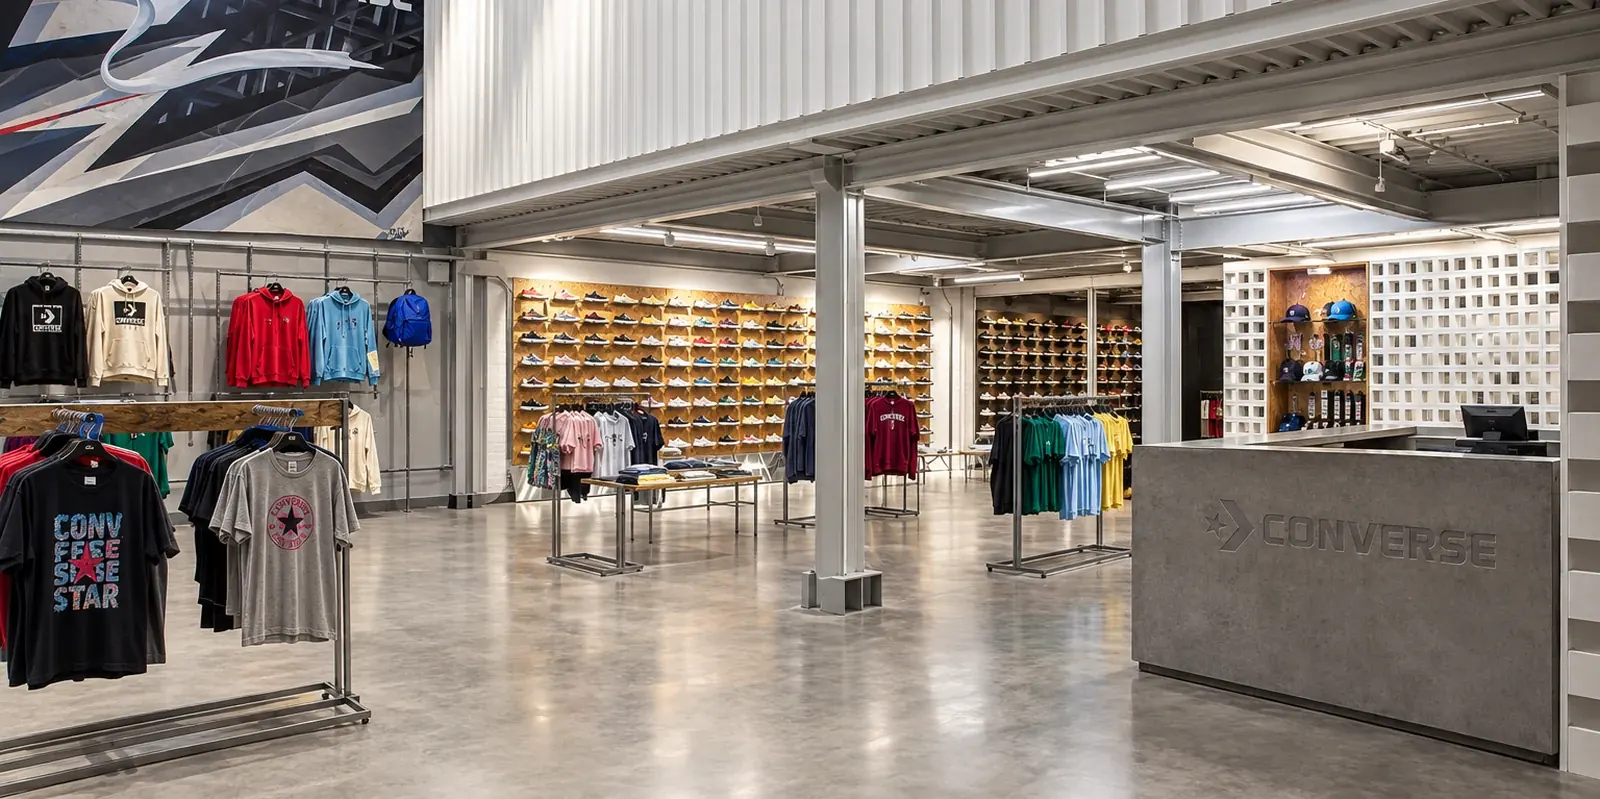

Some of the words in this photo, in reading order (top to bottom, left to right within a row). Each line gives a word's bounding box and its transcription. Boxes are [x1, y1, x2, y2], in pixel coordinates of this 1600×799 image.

[54, 512, 123, 540] CONV
[1263, 513, 1497, 570] CONVERSE
[53, 583, 119, 612] STAR
